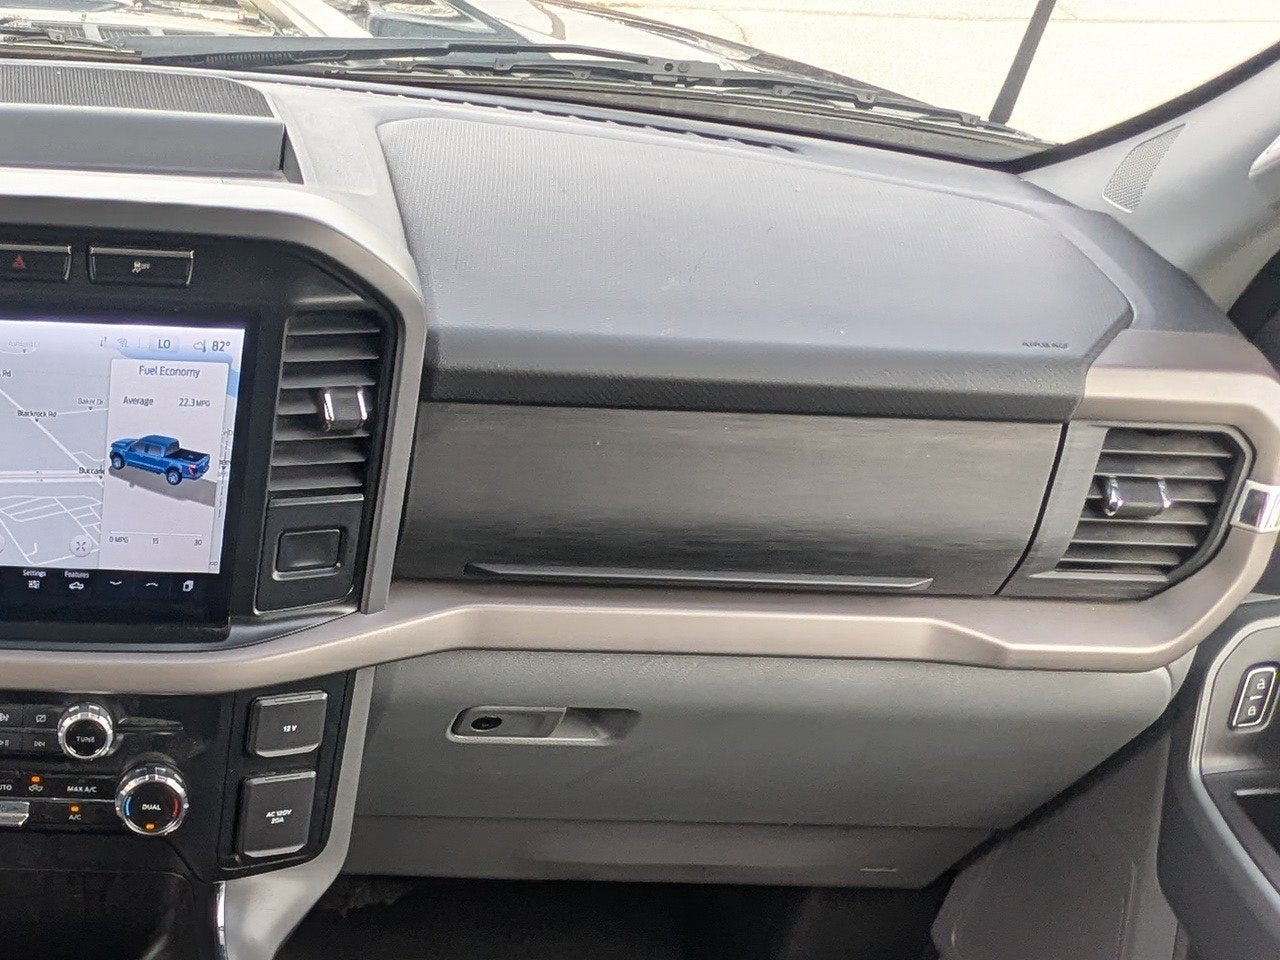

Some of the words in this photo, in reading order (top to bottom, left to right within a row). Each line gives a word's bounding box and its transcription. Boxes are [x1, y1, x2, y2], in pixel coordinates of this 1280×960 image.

[158, 340, 170, 349] LO
[138, 366, 158, 376] Fuel
[160, 366, 200, 378] Economy
[122, 396, 154, 406] Average
[17, 410, 46, 418] Blackrock
[22, 570, 46, 578] Settings
[64, 570, 90, 579] Features
[76, 735, 96, 743] TUNE
[66, 785, 84, 793] MAX
[84, 786, 98, 794] A/C
[142, 803, 162, 812] DUAL
[68, 814, 82, 822] A/C
